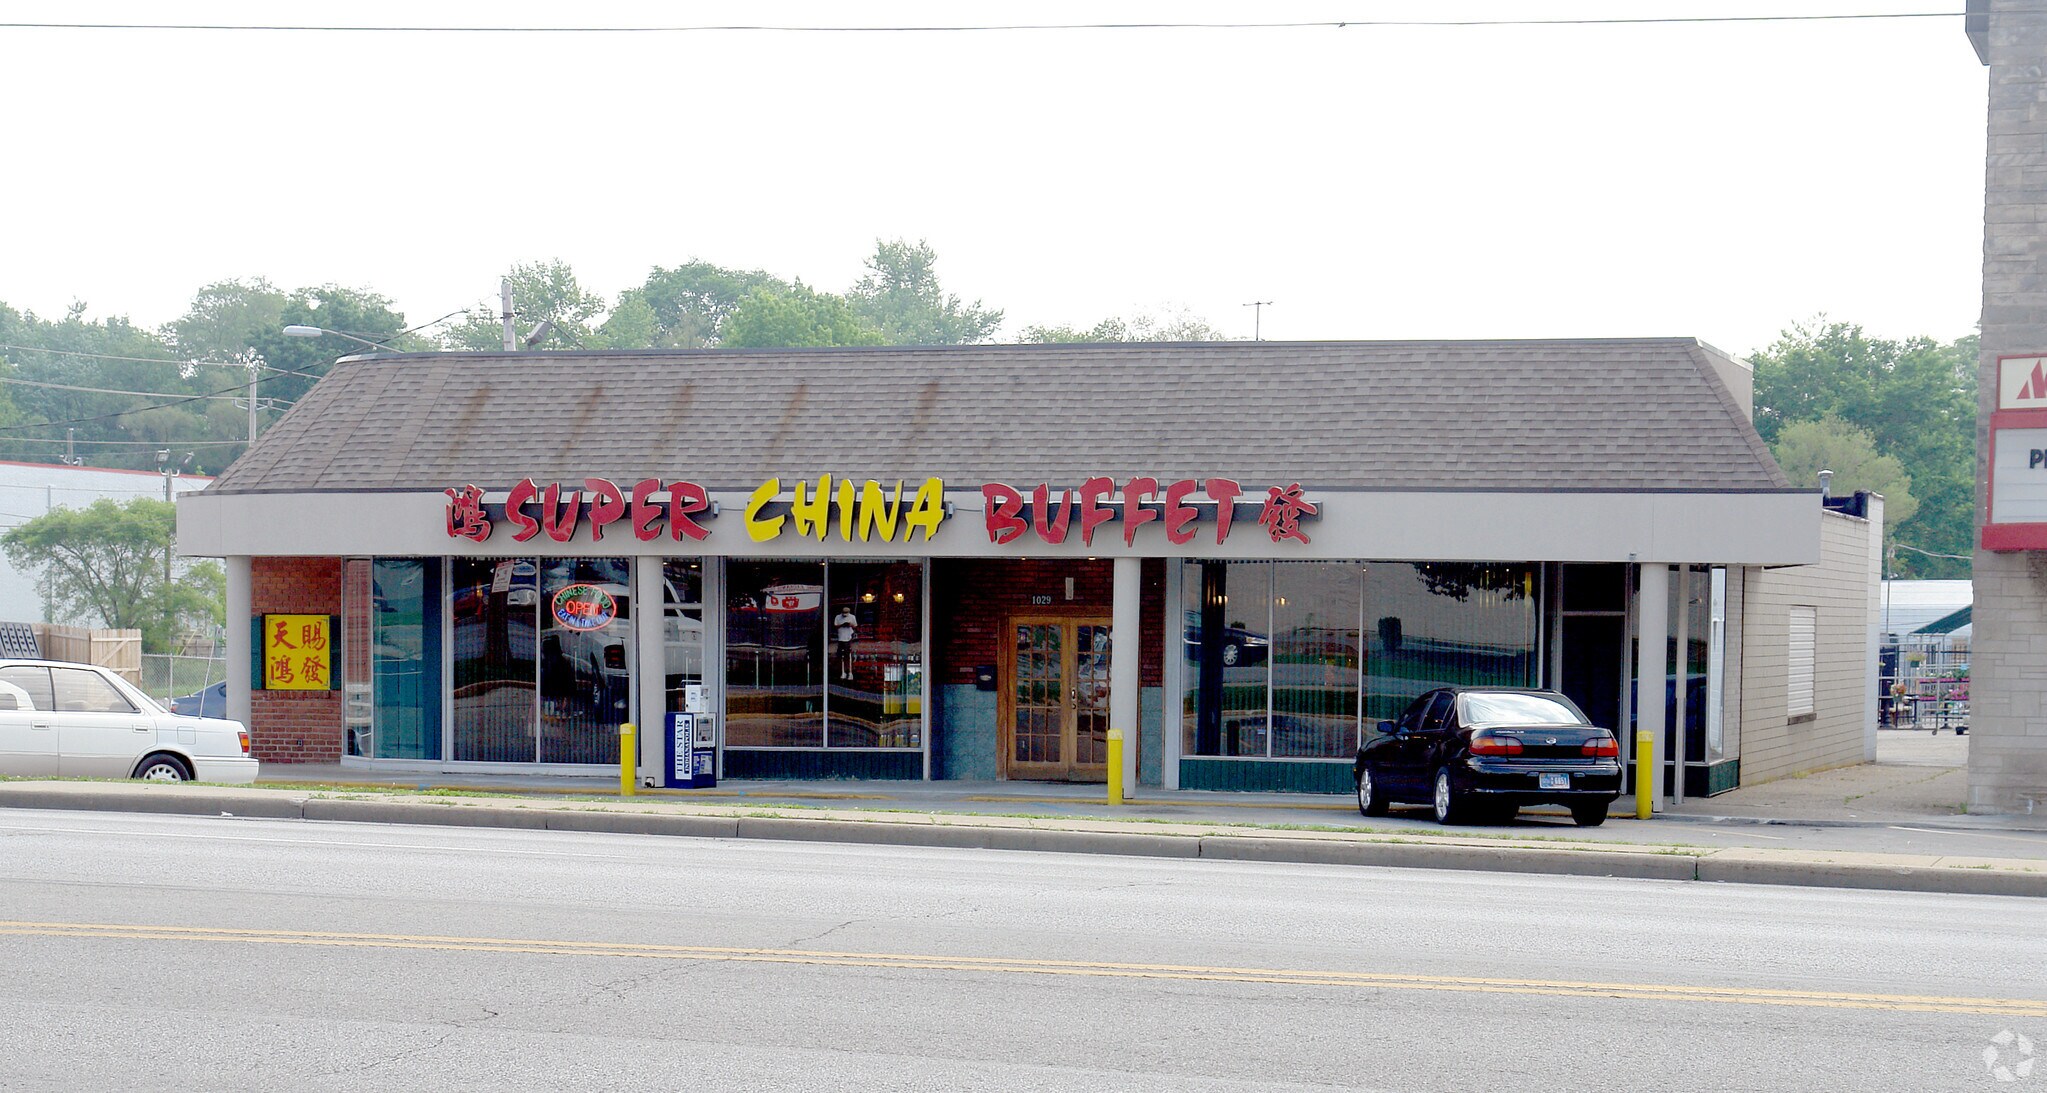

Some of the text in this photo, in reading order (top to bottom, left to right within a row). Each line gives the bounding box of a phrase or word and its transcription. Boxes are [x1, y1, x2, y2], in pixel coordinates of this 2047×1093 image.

[444, 484, 494, 543] 鴻
[505, 472, 1243, 548] SUPER CHINA BUFFET
[1258, 482, 1319, 545] 發
[555, 585, 612, 609] CHINESE FOOD
[566, 600, 600, 616] OPEN
[1032, 595, 1052, 605] 1029
[271, 620, 327, 651] 天賜
[270, 654, 327, 685] 鴻發
[676, 720, 684, 773] THE STAR
